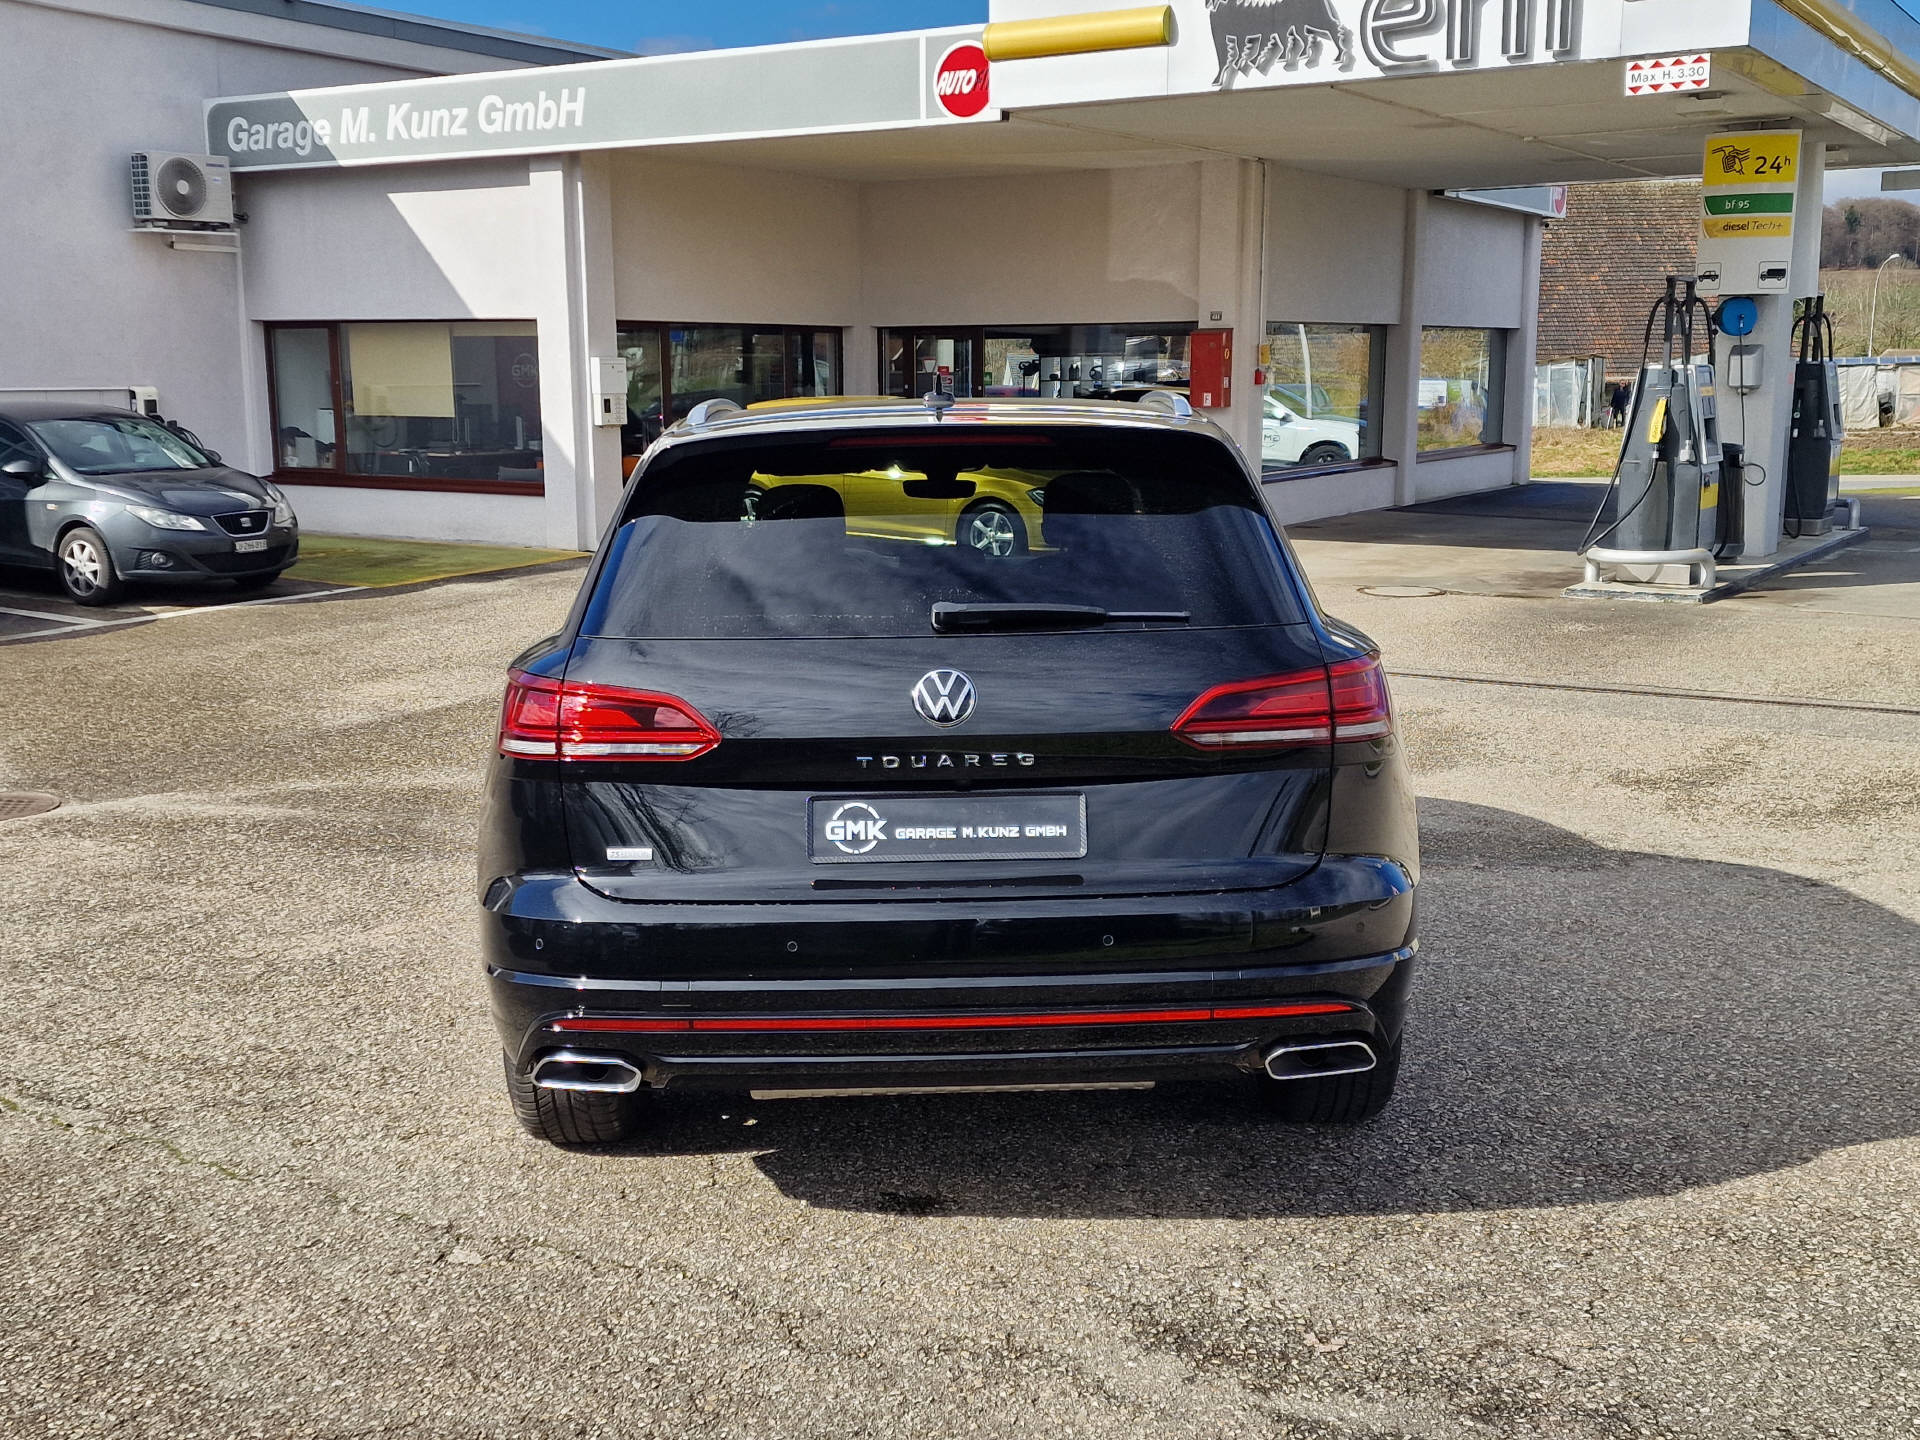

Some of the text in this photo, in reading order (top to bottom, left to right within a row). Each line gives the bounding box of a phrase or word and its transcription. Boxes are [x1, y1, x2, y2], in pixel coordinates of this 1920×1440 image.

[1631, 65, 1705, 84] Max H. 3.30
[227, 87, 586, 156] Garage M. Kunz GmbH
[1725, 200, 1750, 209] bf 95
[1722, 220, 1784, 232] diesel Tech+
[856, 752, 1035, 769] TOUAREG
[825, 818, 888, 841] GMK
[895, 827, 957, 840] GARAGE
[1025, 825, 1067, 838] GMBH
